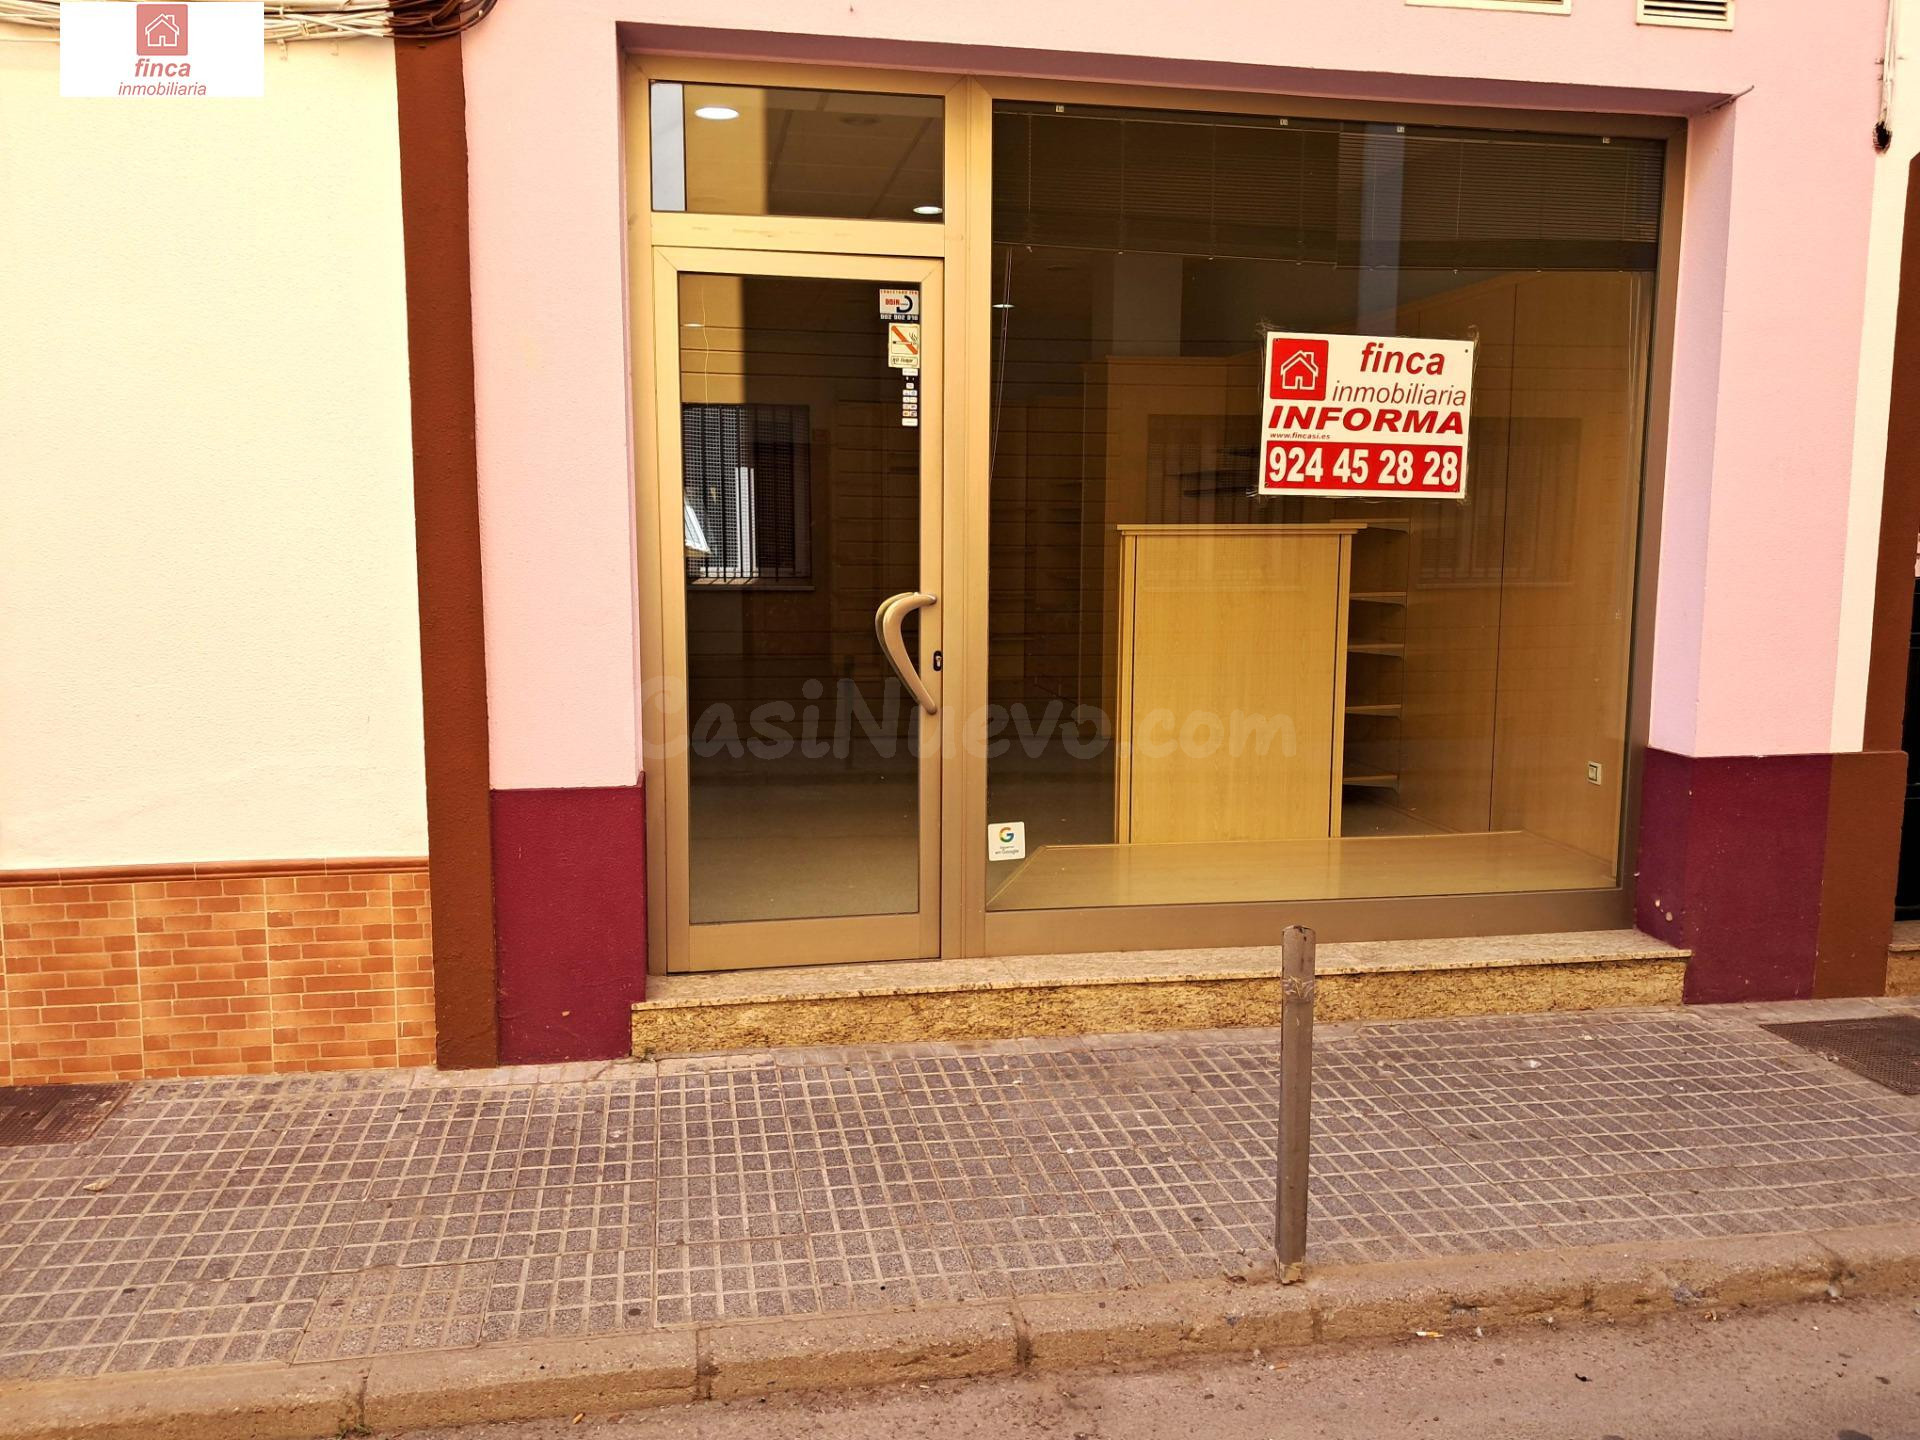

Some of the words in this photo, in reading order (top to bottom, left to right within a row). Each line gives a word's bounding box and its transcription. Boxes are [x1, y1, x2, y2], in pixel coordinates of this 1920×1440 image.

[1360, 342, 1445, 375] finca
[1332, 380, 1466, 406] inmobiliaria
[1268, 406, 1464, 434] INFORMA
[1269, 432, 1331, 440] www.fincasi.es
[1269, 446, 1324, 483] 924
[1332, 448, 1369, 484] 45
[1377, 450, 1414, 485] 28
[1422, 451, 1459, 487] 28
